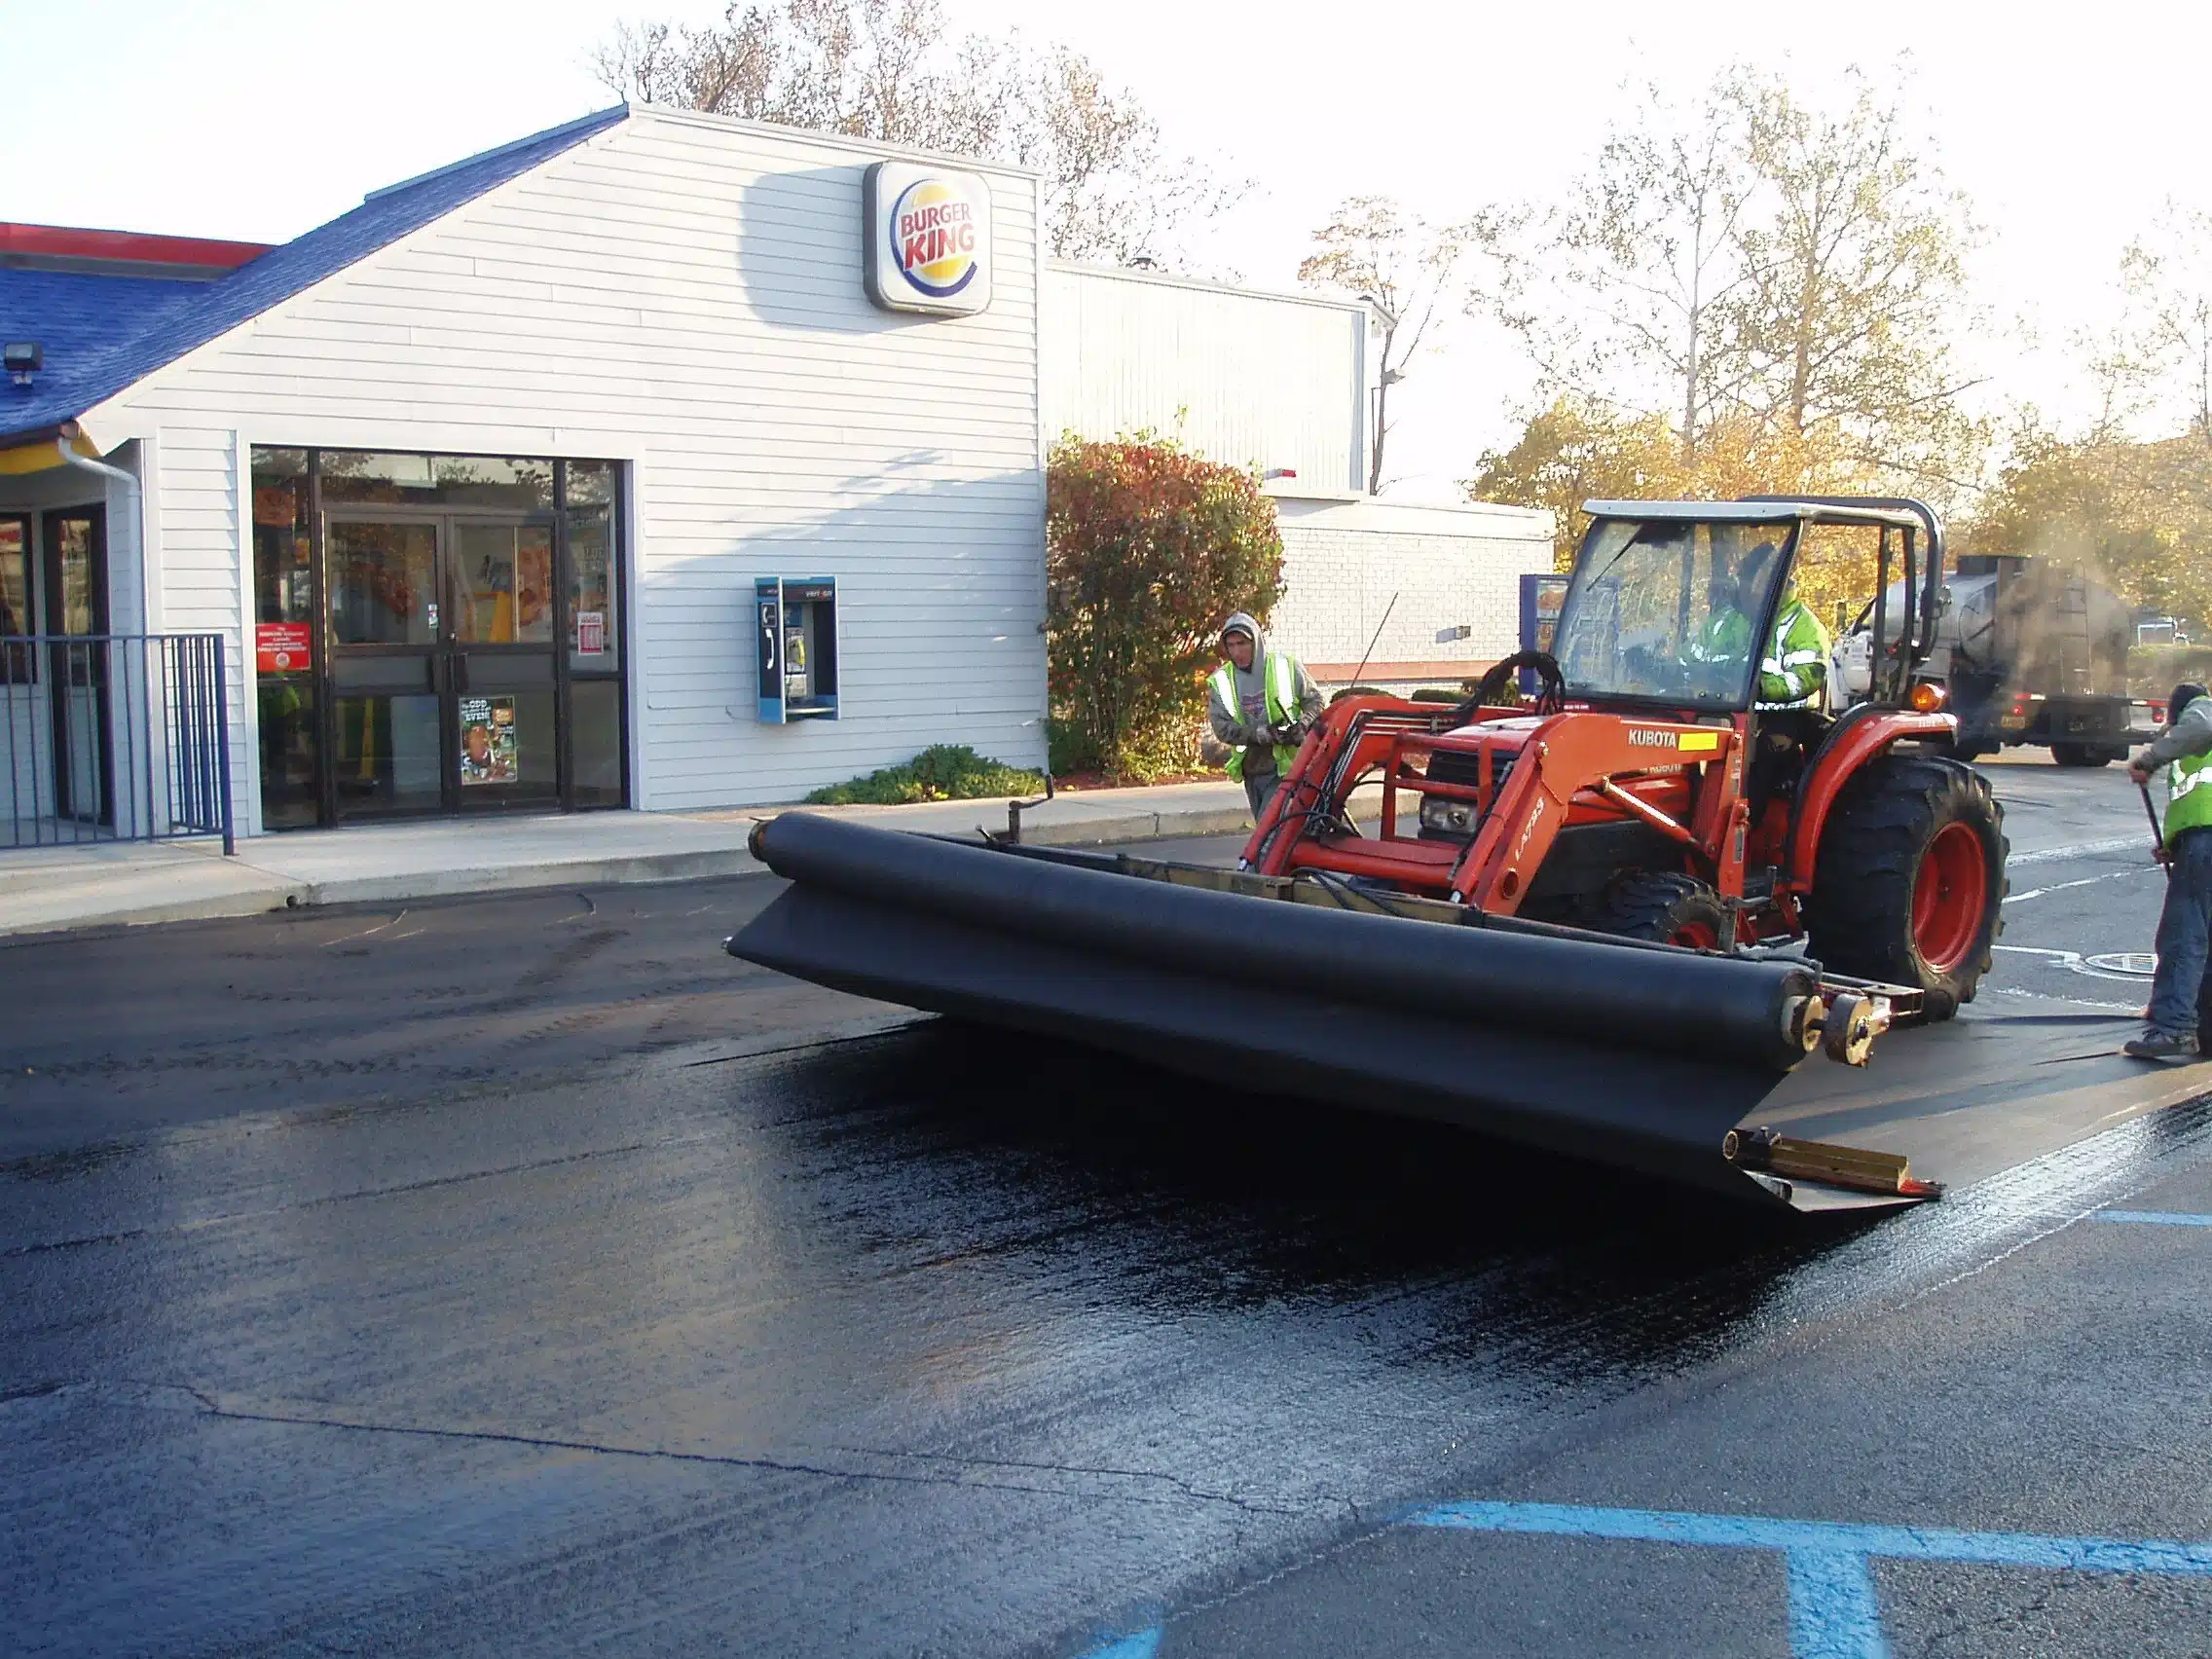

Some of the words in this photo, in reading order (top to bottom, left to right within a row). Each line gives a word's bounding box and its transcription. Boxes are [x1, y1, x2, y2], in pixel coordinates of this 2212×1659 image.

[901, 203, 972, 238] BURGER
[904, 224, 974, 270] KING
[1628, 728, 1677, 749] KUBOTA
